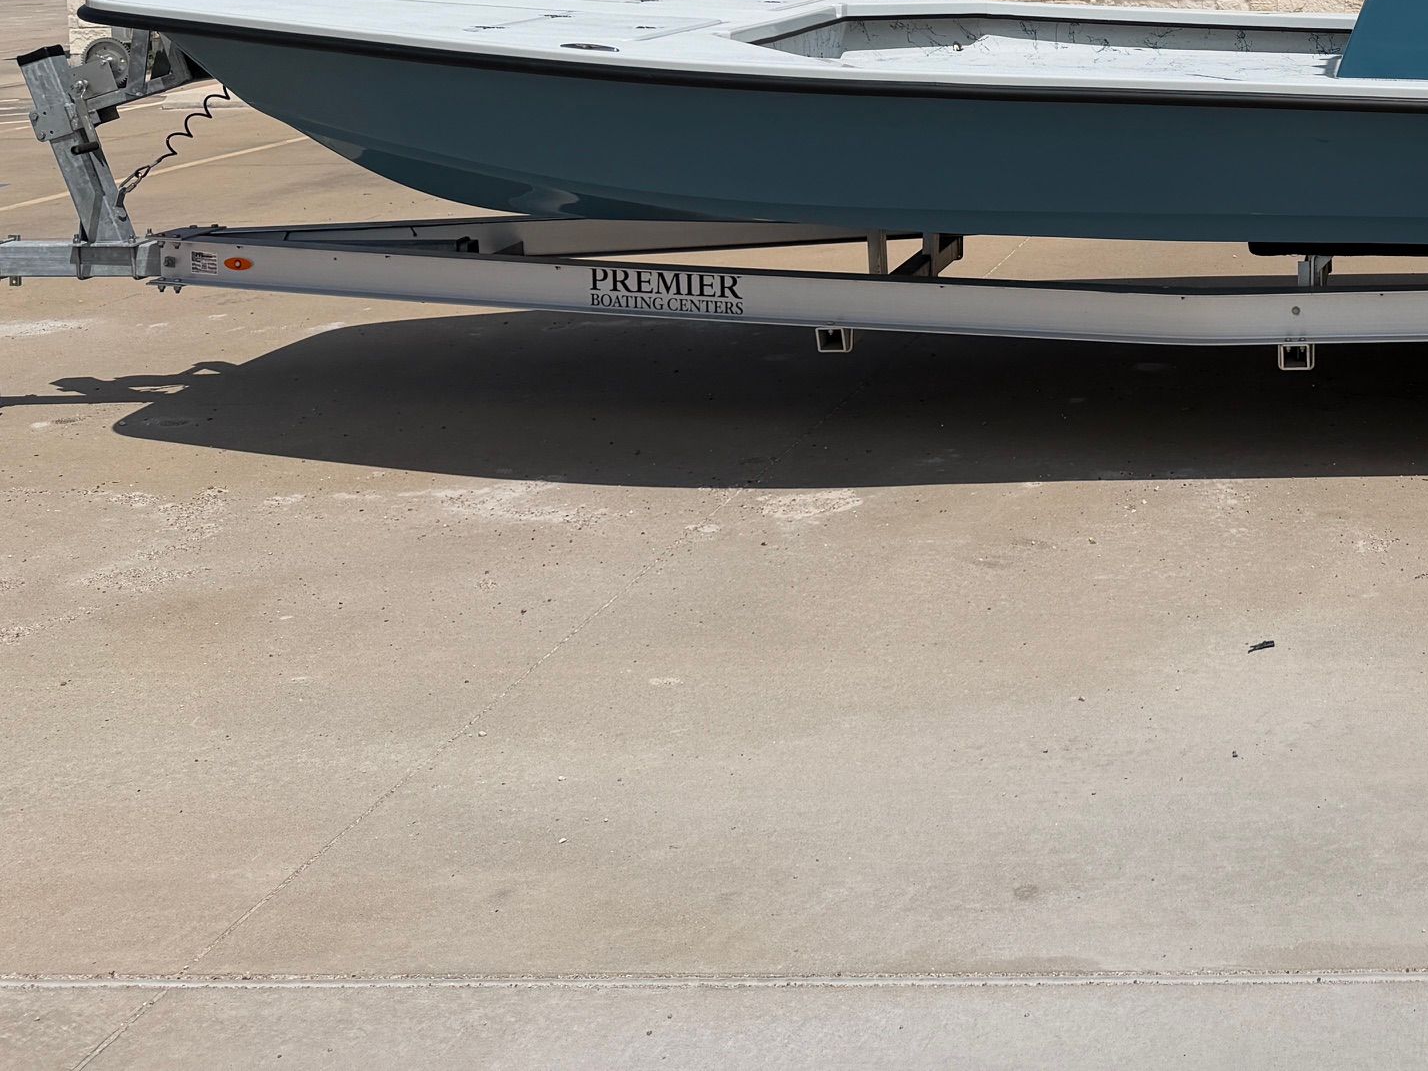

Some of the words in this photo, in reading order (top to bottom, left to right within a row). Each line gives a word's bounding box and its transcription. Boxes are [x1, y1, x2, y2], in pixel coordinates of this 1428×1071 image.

[590, 268, 743, 300] PREMIER
[590, 293, 664, 311] BOATING
[667, 297, 744, 315] CENTERS
